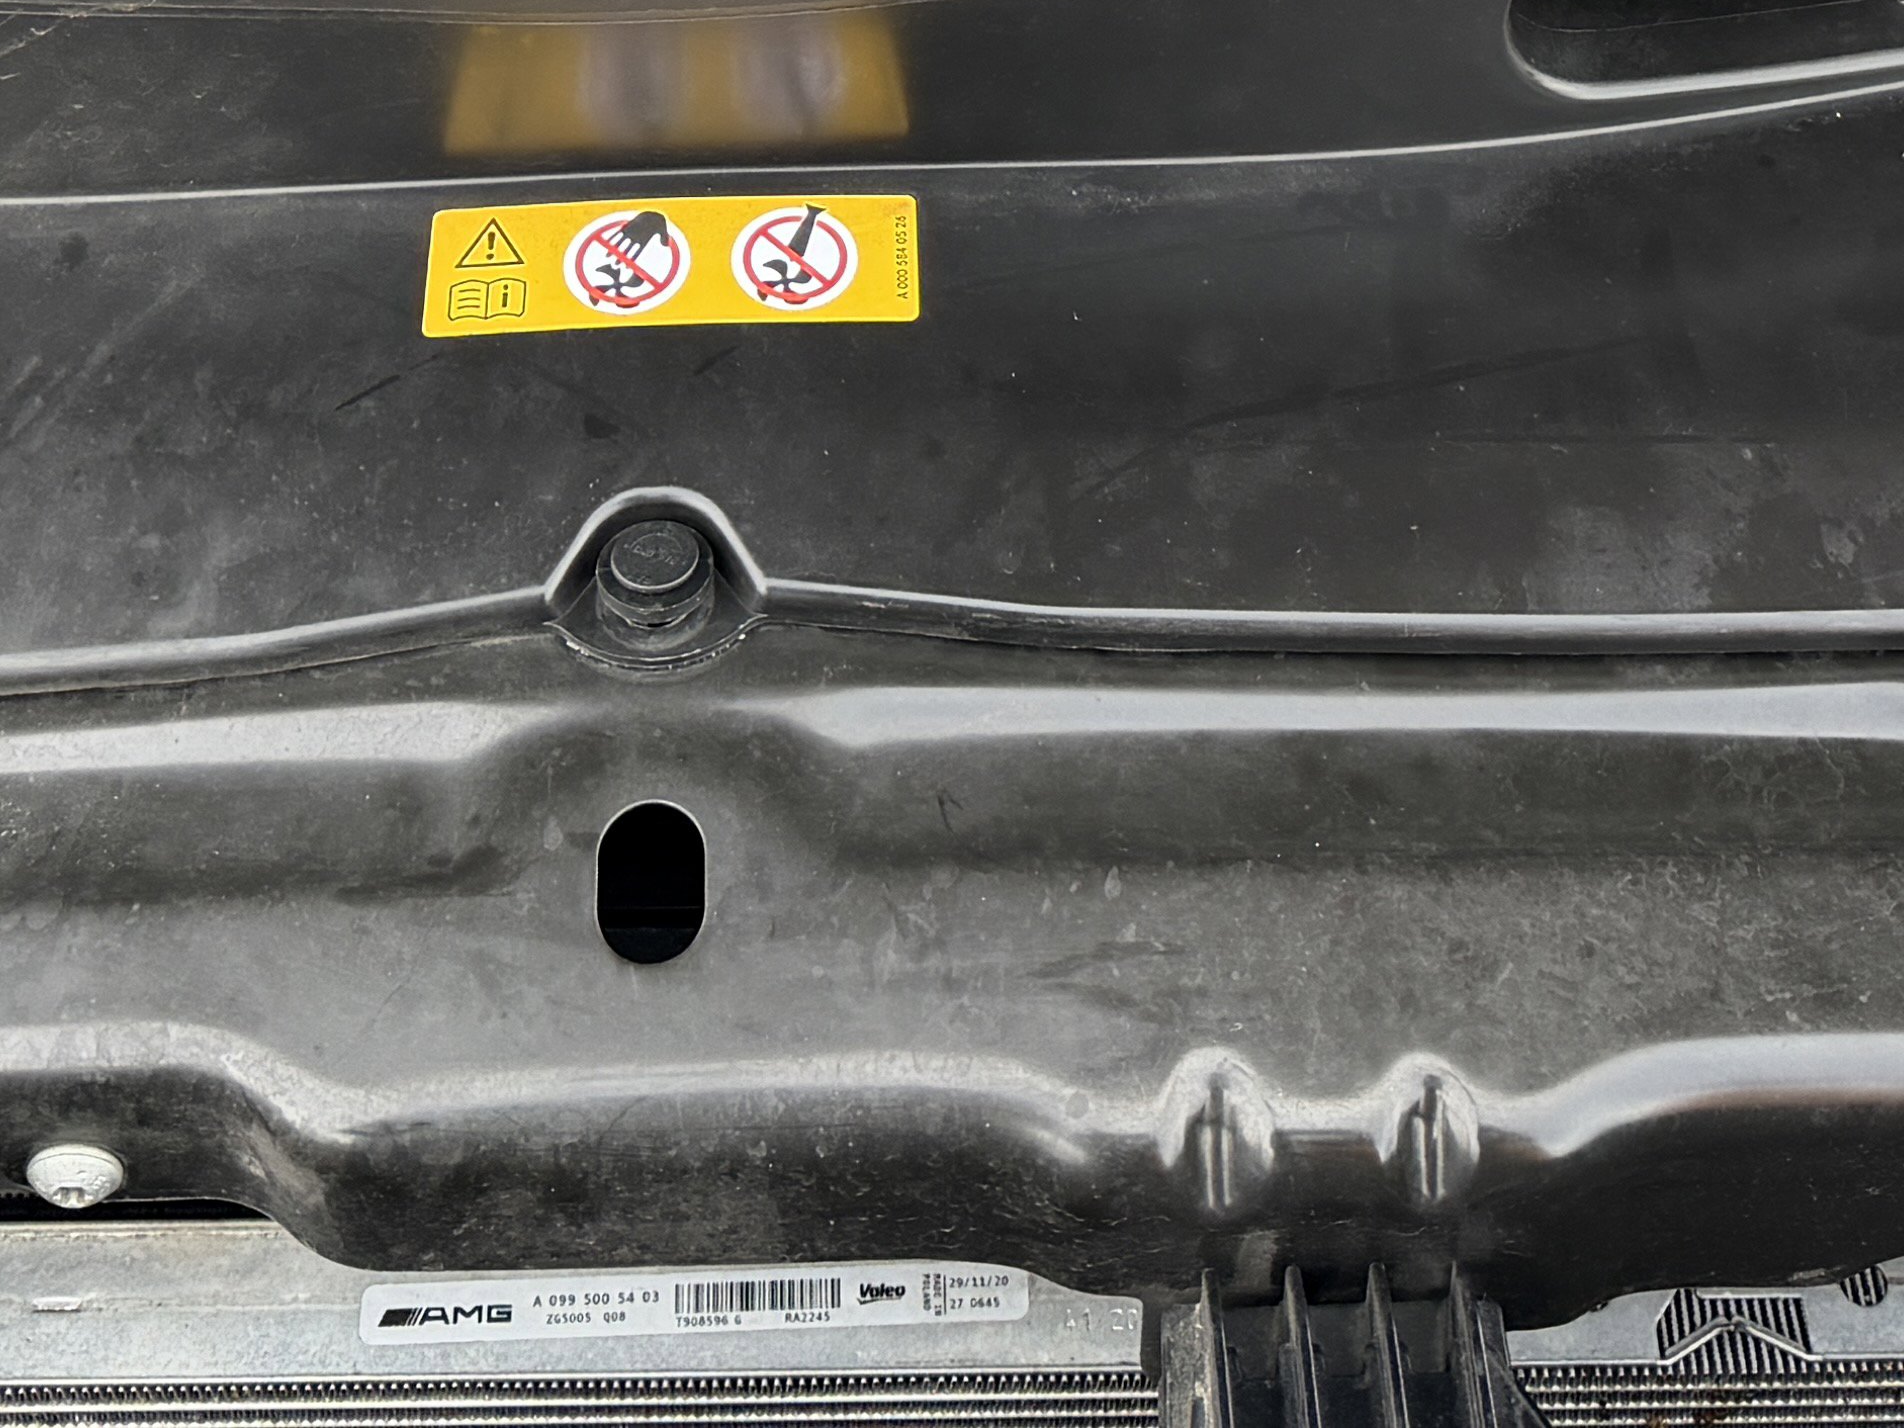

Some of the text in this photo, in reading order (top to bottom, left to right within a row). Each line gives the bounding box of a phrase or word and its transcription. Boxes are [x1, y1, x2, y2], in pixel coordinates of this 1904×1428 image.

[948, 1274, 1010, 1289] 29/11/20
[859, 1281, 906, 1300] Valeo
[418, 1290, 661, 1326] AMG A 099 500 54 03
[949, 1298, 964, 1310] 27
